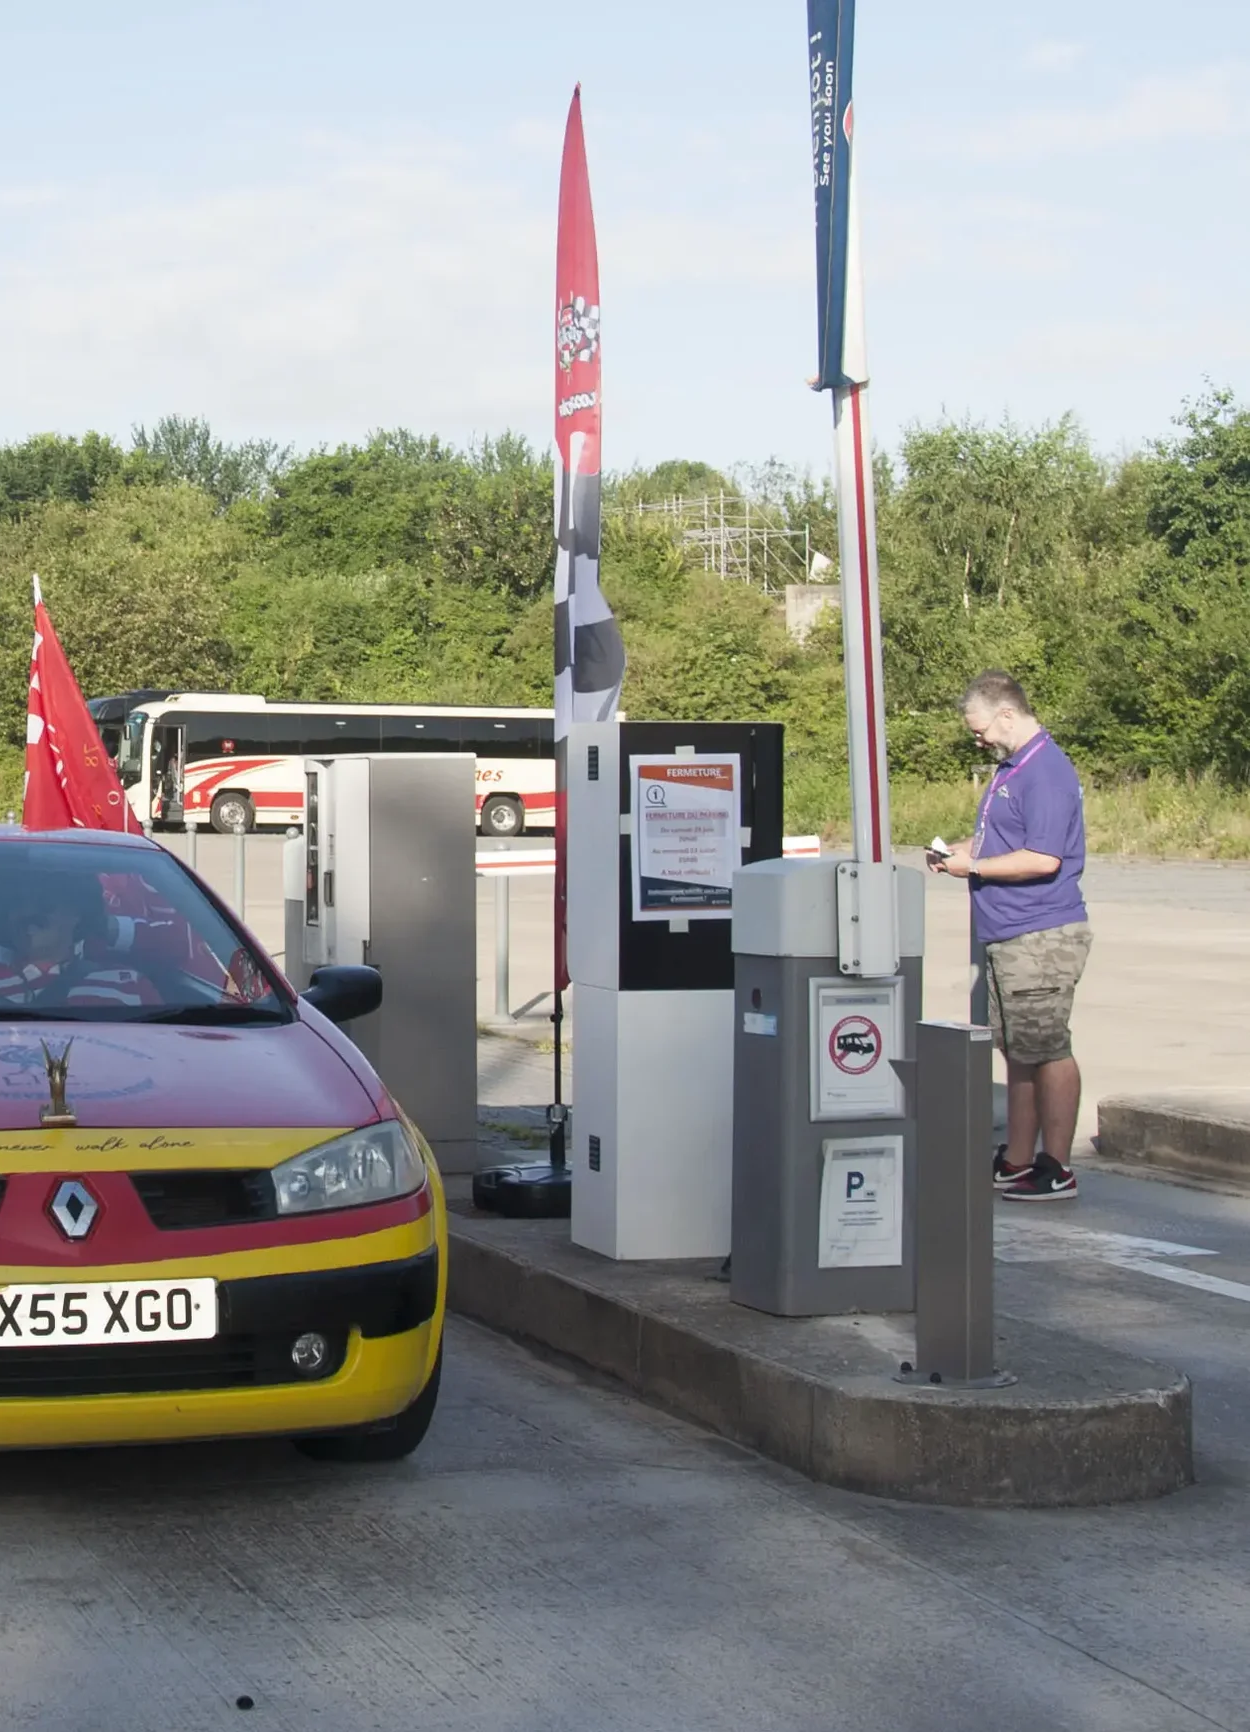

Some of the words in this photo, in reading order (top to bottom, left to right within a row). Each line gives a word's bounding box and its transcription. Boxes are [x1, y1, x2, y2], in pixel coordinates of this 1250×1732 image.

[824, 60, 834, 106] soon
[823, 113, 832, 146] you
[820, 151, 831, 186] See
[666, 768, 721, 778] FERMETURE
[75, 1136, 129, 1151] walk
[139, 1136, 195, 1150] alone
